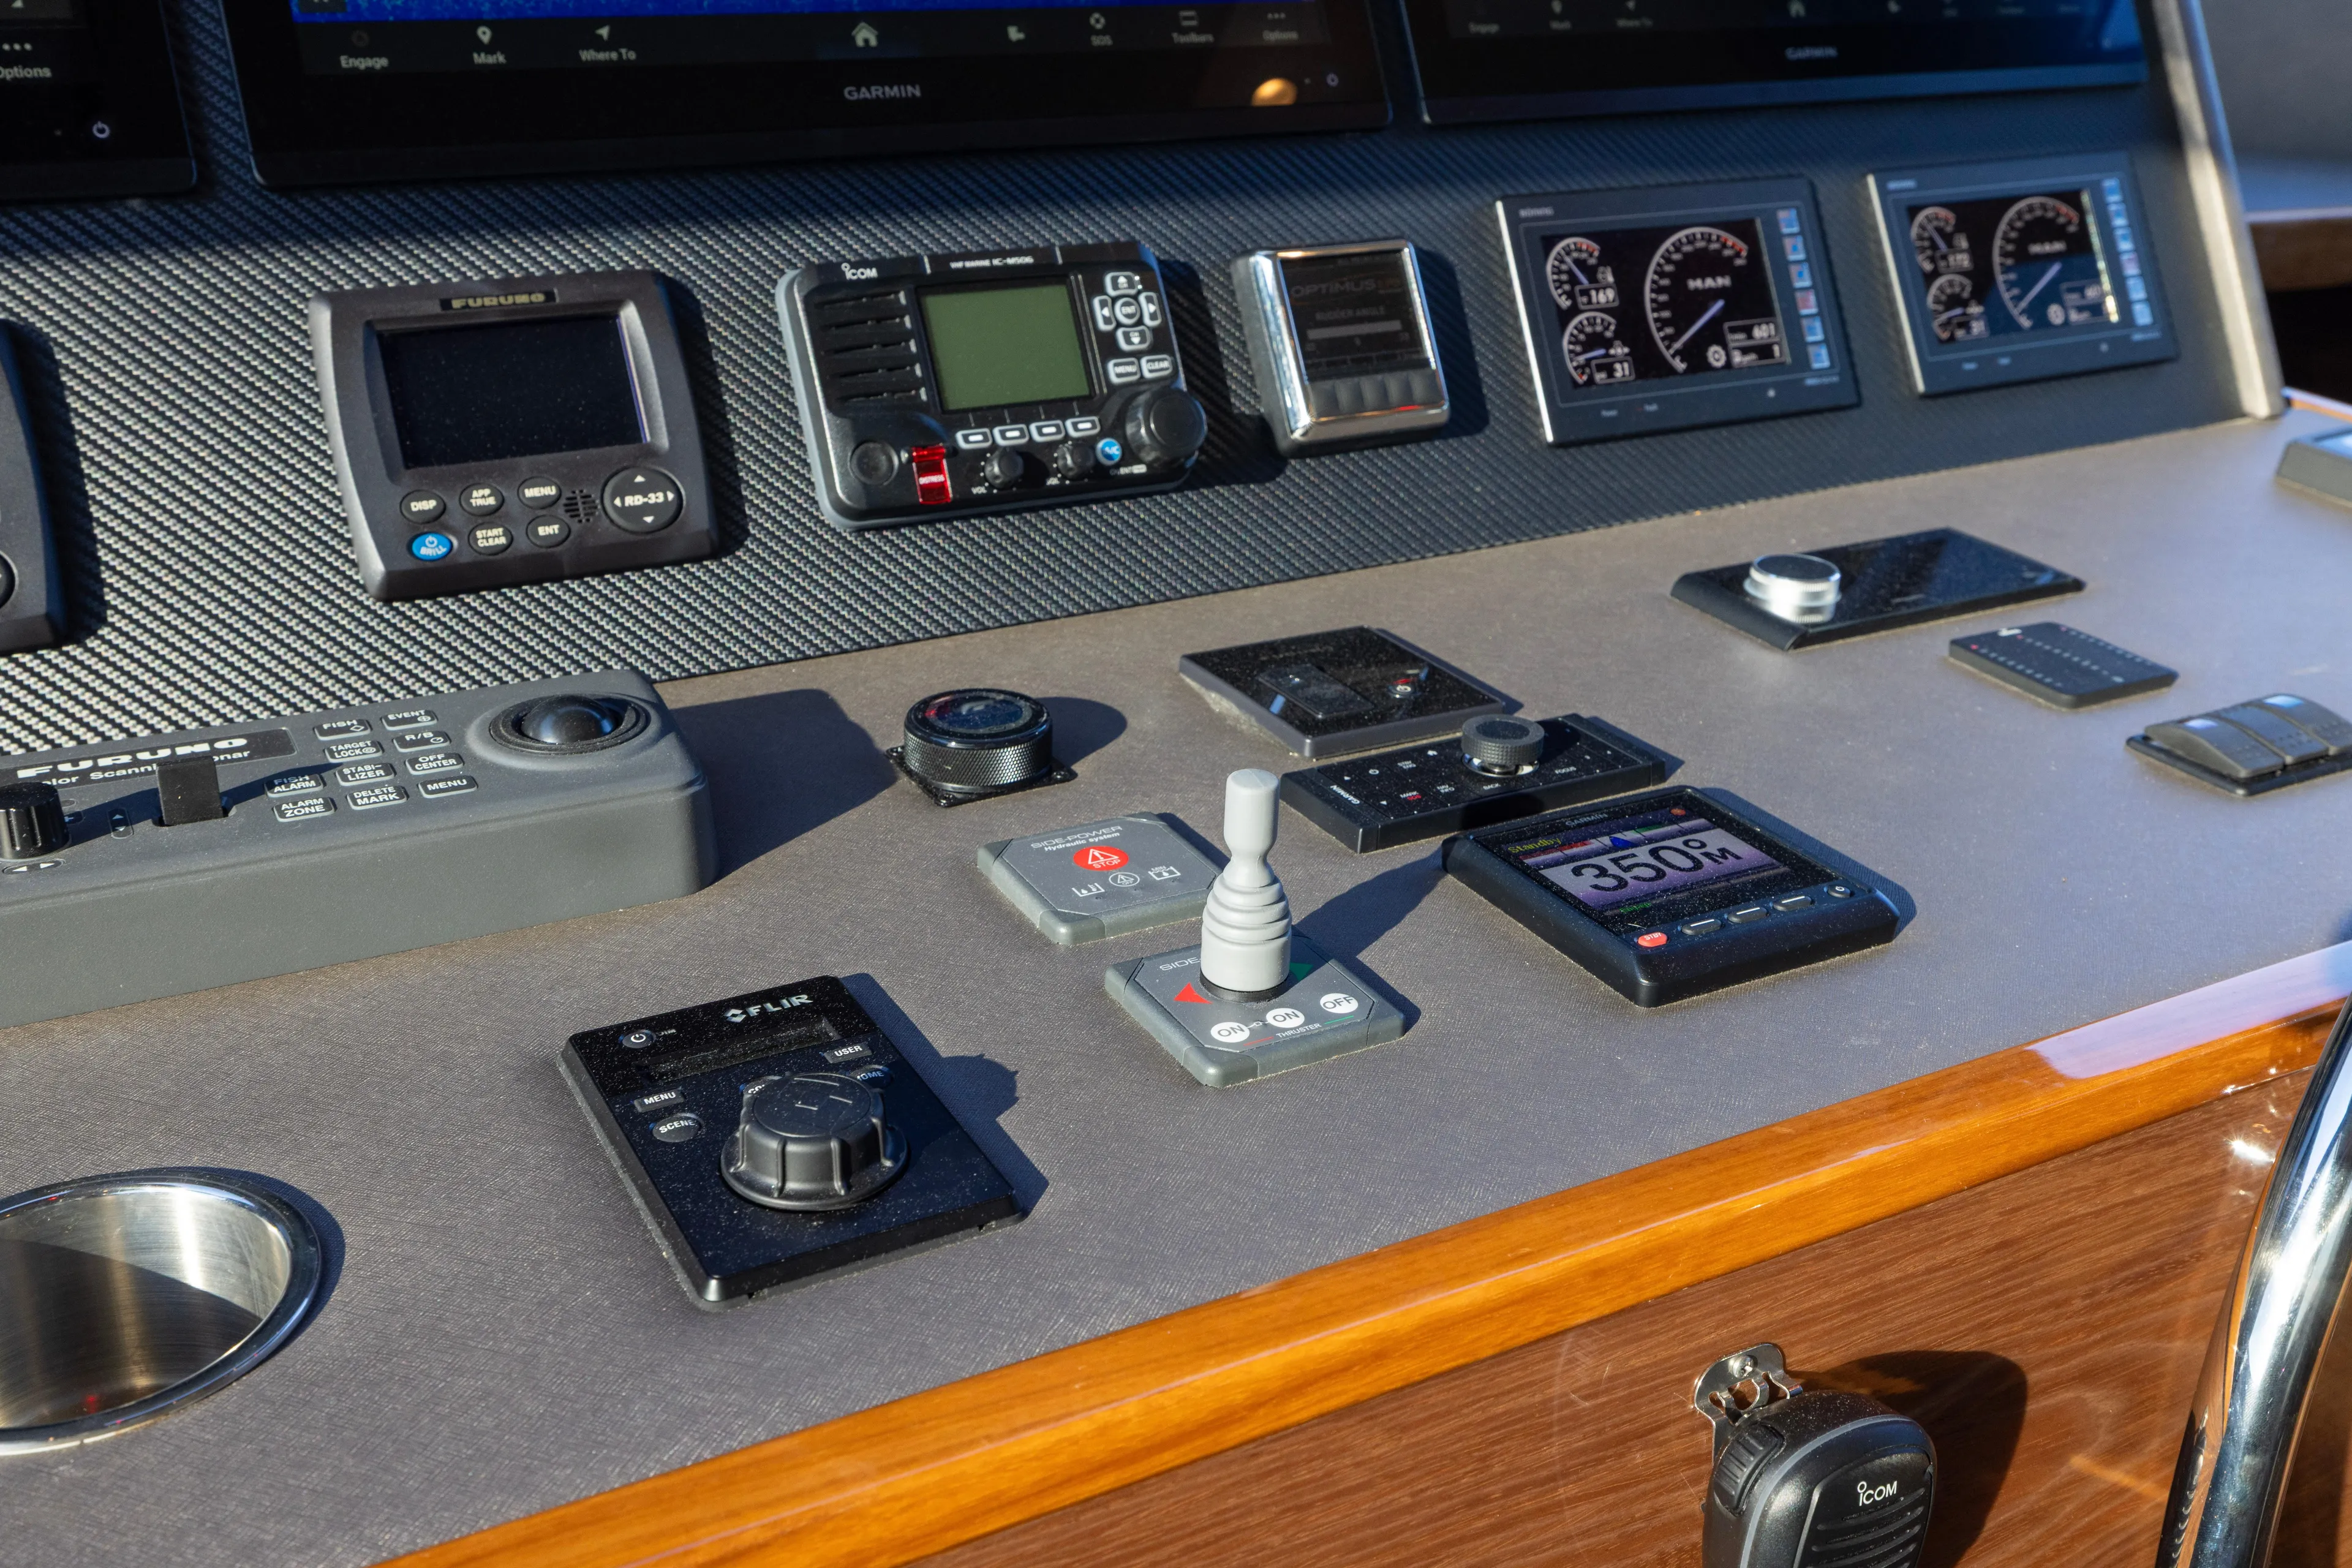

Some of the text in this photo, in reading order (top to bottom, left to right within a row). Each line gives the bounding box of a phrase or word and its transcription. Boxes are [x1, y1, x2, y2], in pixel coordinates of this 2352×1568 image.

[473, 50, 507, 64] Mark
[579, 48, 637, 62] Where To
[340, 55, 389, 70] Engage
[843, 84, 921, 100] GARMIN
[451, 293, 546, 309] FURUNO
[472, 488, 491, 498] APP
[524, 486, 556, 498] MENU
[410, 499, 437, 512] DISP
[470, 497, 496, 507] TRUE
[624, 492, 664, 507] RD-33
[476, 527, 503, 538] START
[537, 524, 560, 536] ENT
[478, 536, 507, 547] CLEAR
[420, 545, 447, 557] BRILL
[387, 709, 426, 720] EVENT
[322, 719, 358, 729] FISH
[404, 731, 434, 741] R/B
[330, 741, 372, 752] TARGET
[17, 737, 247, 778] FURUNO
[335, 748, 363, 759] LOCK
[418, 753, 445, 763] OFF
[415, 758, 457, 771] CENTER
[274, 775, 310, 785] FISH
[347, 769, 385, 781] LIZER
[274, 780, 316, 793] ALARM
[427, 779, 467, 791] MENU
[353, 786, 396, 798] DELETE
[1330, 785, 1360, 804] GARMIN
[281, 798, 323, 810] ALARM
[357, 793, 399, 806] MARK
[284, 805, 325, 818] ZONE
[1565, 813, 1608, 826] GARMIN
[1031, 826, 1123, 848] SIDE-POWER
[1044, 832, 1120, 852] Hydraulic system
[1508, 837, 1562, 854] Standby
[1093, 859, 1121, 869] STOP
[1643, 932, 1662, 940] STBY
[745, 994, 814, 1017] FLIR
[1322, 997, 1355, 1010] OFF
[1272, 1011, 1300, 1023] ON
[1217, 1025, 1245, 1038] ON
[1276, 1023, 1322, 1038] THRUSTER
[834, 1045, 862, 1057] USER
[643, 1091, 676, 1105] MENU
[659, 1120, 695, 1134] SCENE
